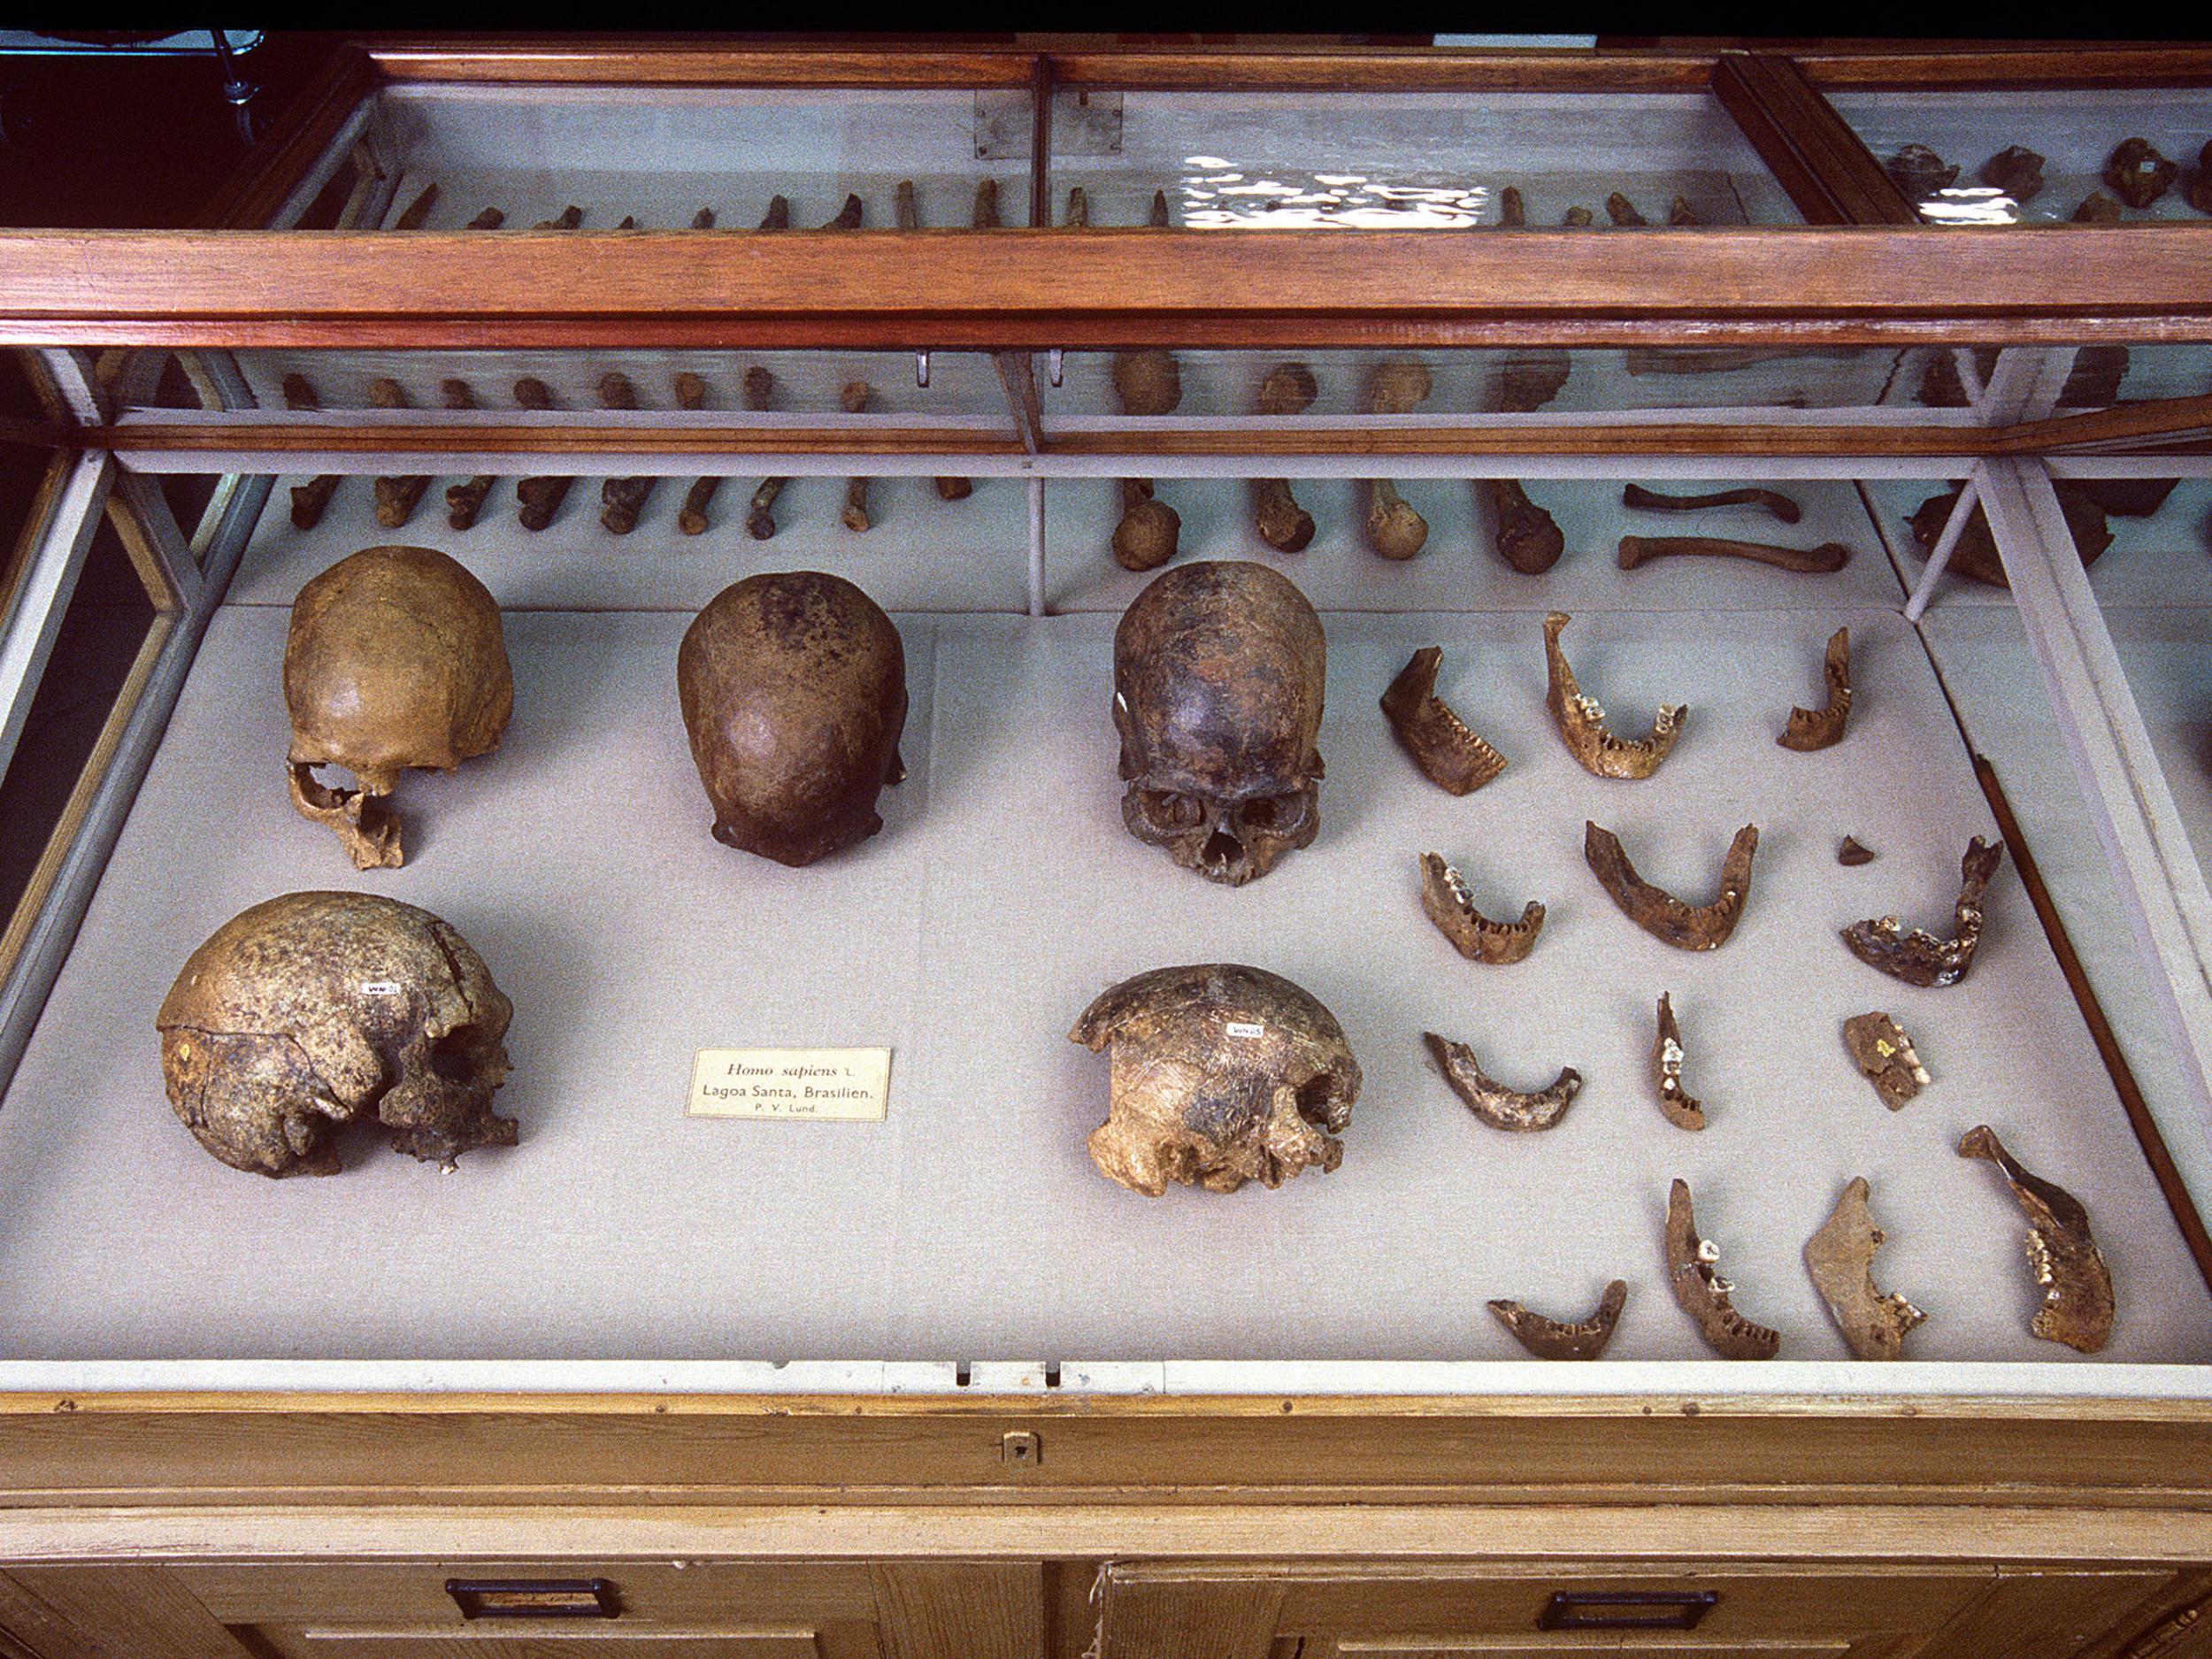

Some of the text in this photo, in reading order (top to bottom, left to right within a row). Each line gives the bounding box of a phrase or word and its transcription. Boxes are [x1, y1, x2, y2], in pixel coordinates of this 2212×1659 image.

[727, 1063, 773, 1076] Homo
[781, 1064, 837, 1079] sapiens
[703, 1084, 873, 1100] Lagoa Santa, Brasilien.
[772, 1103, 782, 1112] V.
[789, 1103, 818, 1114] Lund.
